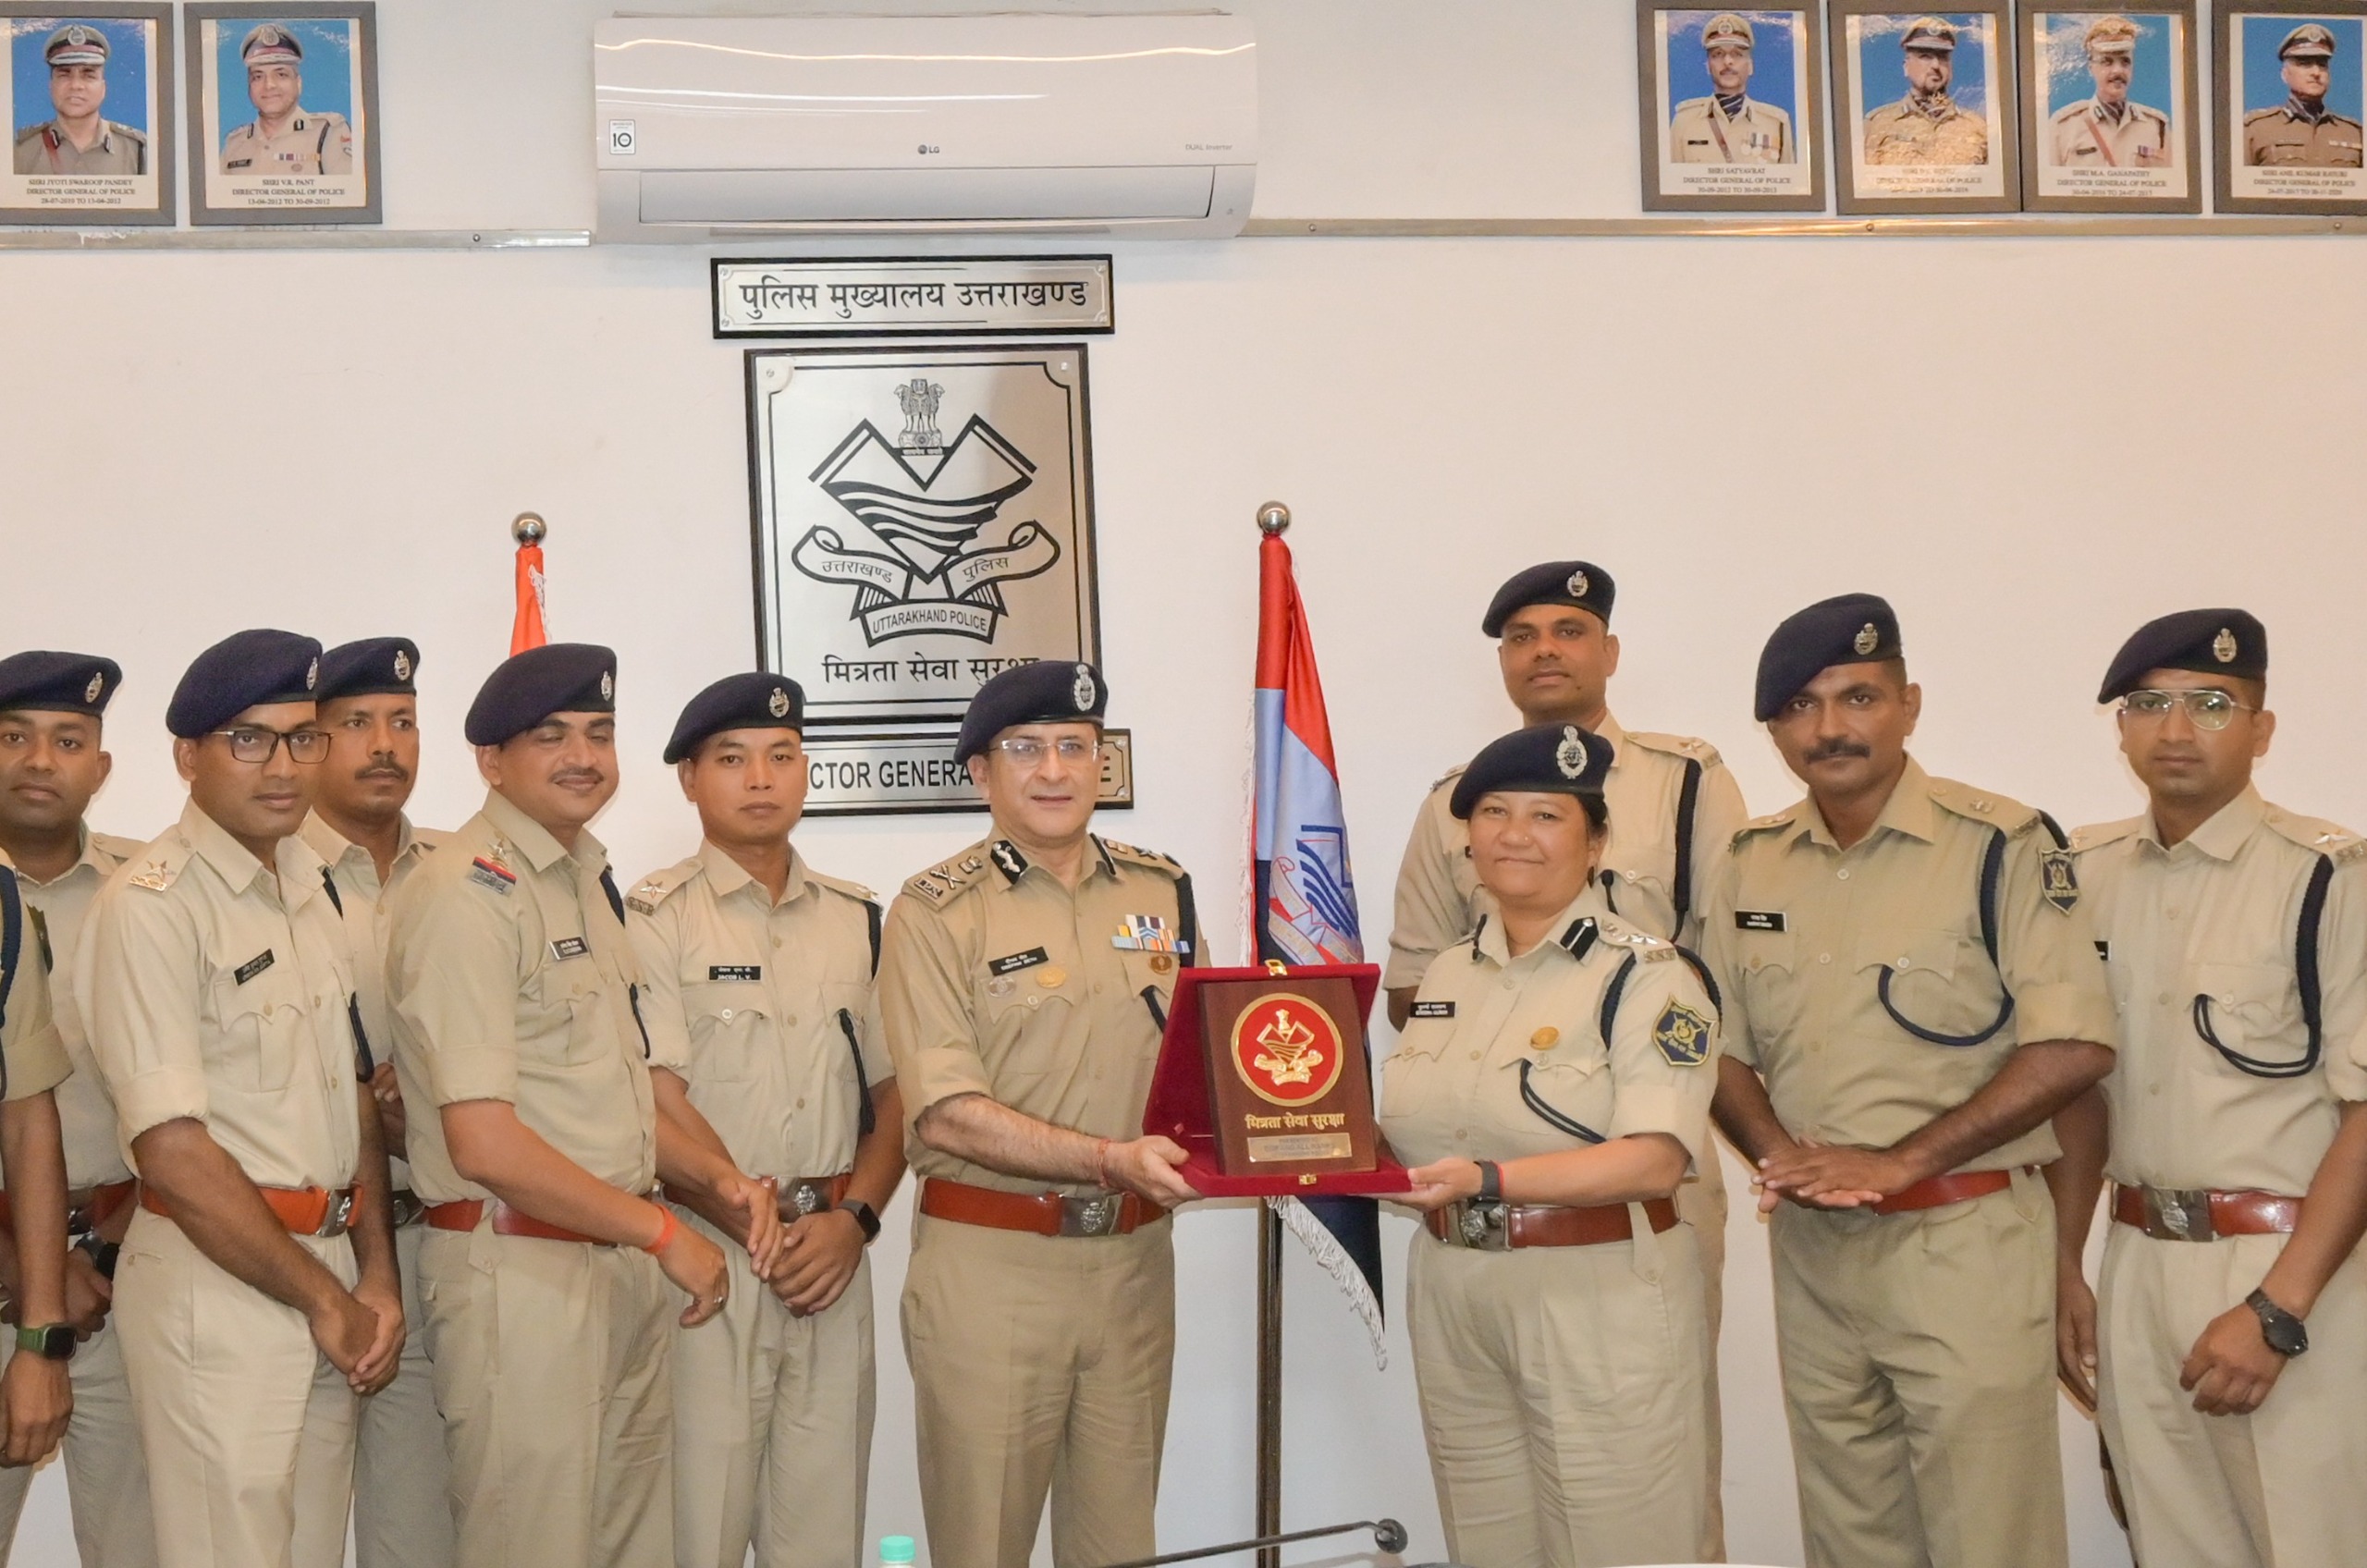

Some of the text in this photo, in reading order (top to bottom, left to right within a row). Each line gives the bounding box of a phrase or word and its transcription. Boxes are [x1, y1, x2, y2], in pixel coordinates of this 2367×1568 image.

[739, 276, 1088, 319] पुलिस मुख्यालय उत्तराखण्ड
[821, 560, 893, 583] उत्तराखण्ड
[963, 557, 1010, 582] पुलिस
[873, 609, 987, 633] UTTARAKHAND POLICE
[821, 654, 900, 683] मित्रता
[906, 651, 960, 682] सेवा
[809, 759, 974, 790] CTOR GENERA
[1282, 1111, 1309, 1128] सेवा
